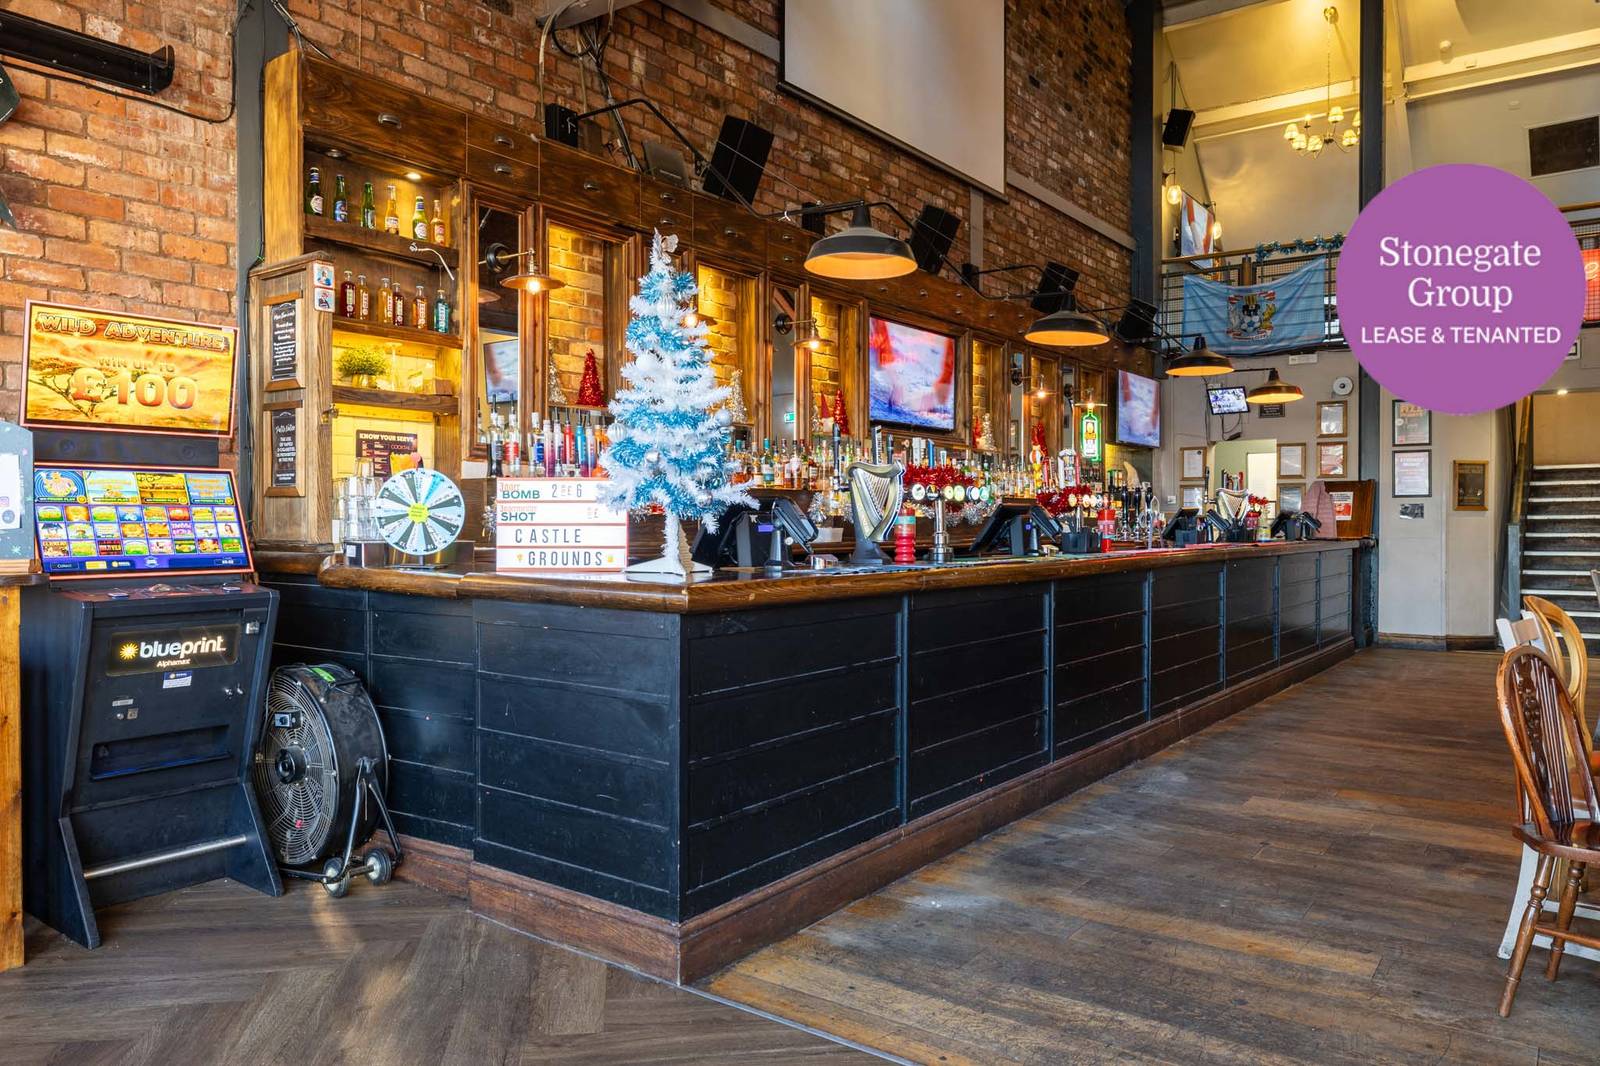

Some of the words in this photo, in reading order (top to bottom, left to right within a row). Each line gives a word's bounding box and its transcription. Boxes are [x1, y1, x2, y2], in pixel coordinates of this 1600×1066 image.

[38, 313, 96, 336] WILD
[70, 367, 197, 410] £100
[359, 432, 379, 440] KNOW
[502, 490, 541, 499] BOMB
[501, 511, 537, 521] SHOT
[515, 528, 582, 543] CASTLE
[528, 551, 602, 566] GROUNDS
[140, 636, 223, 659] blueprint
[157, 659, 191, 669] Alphamax
